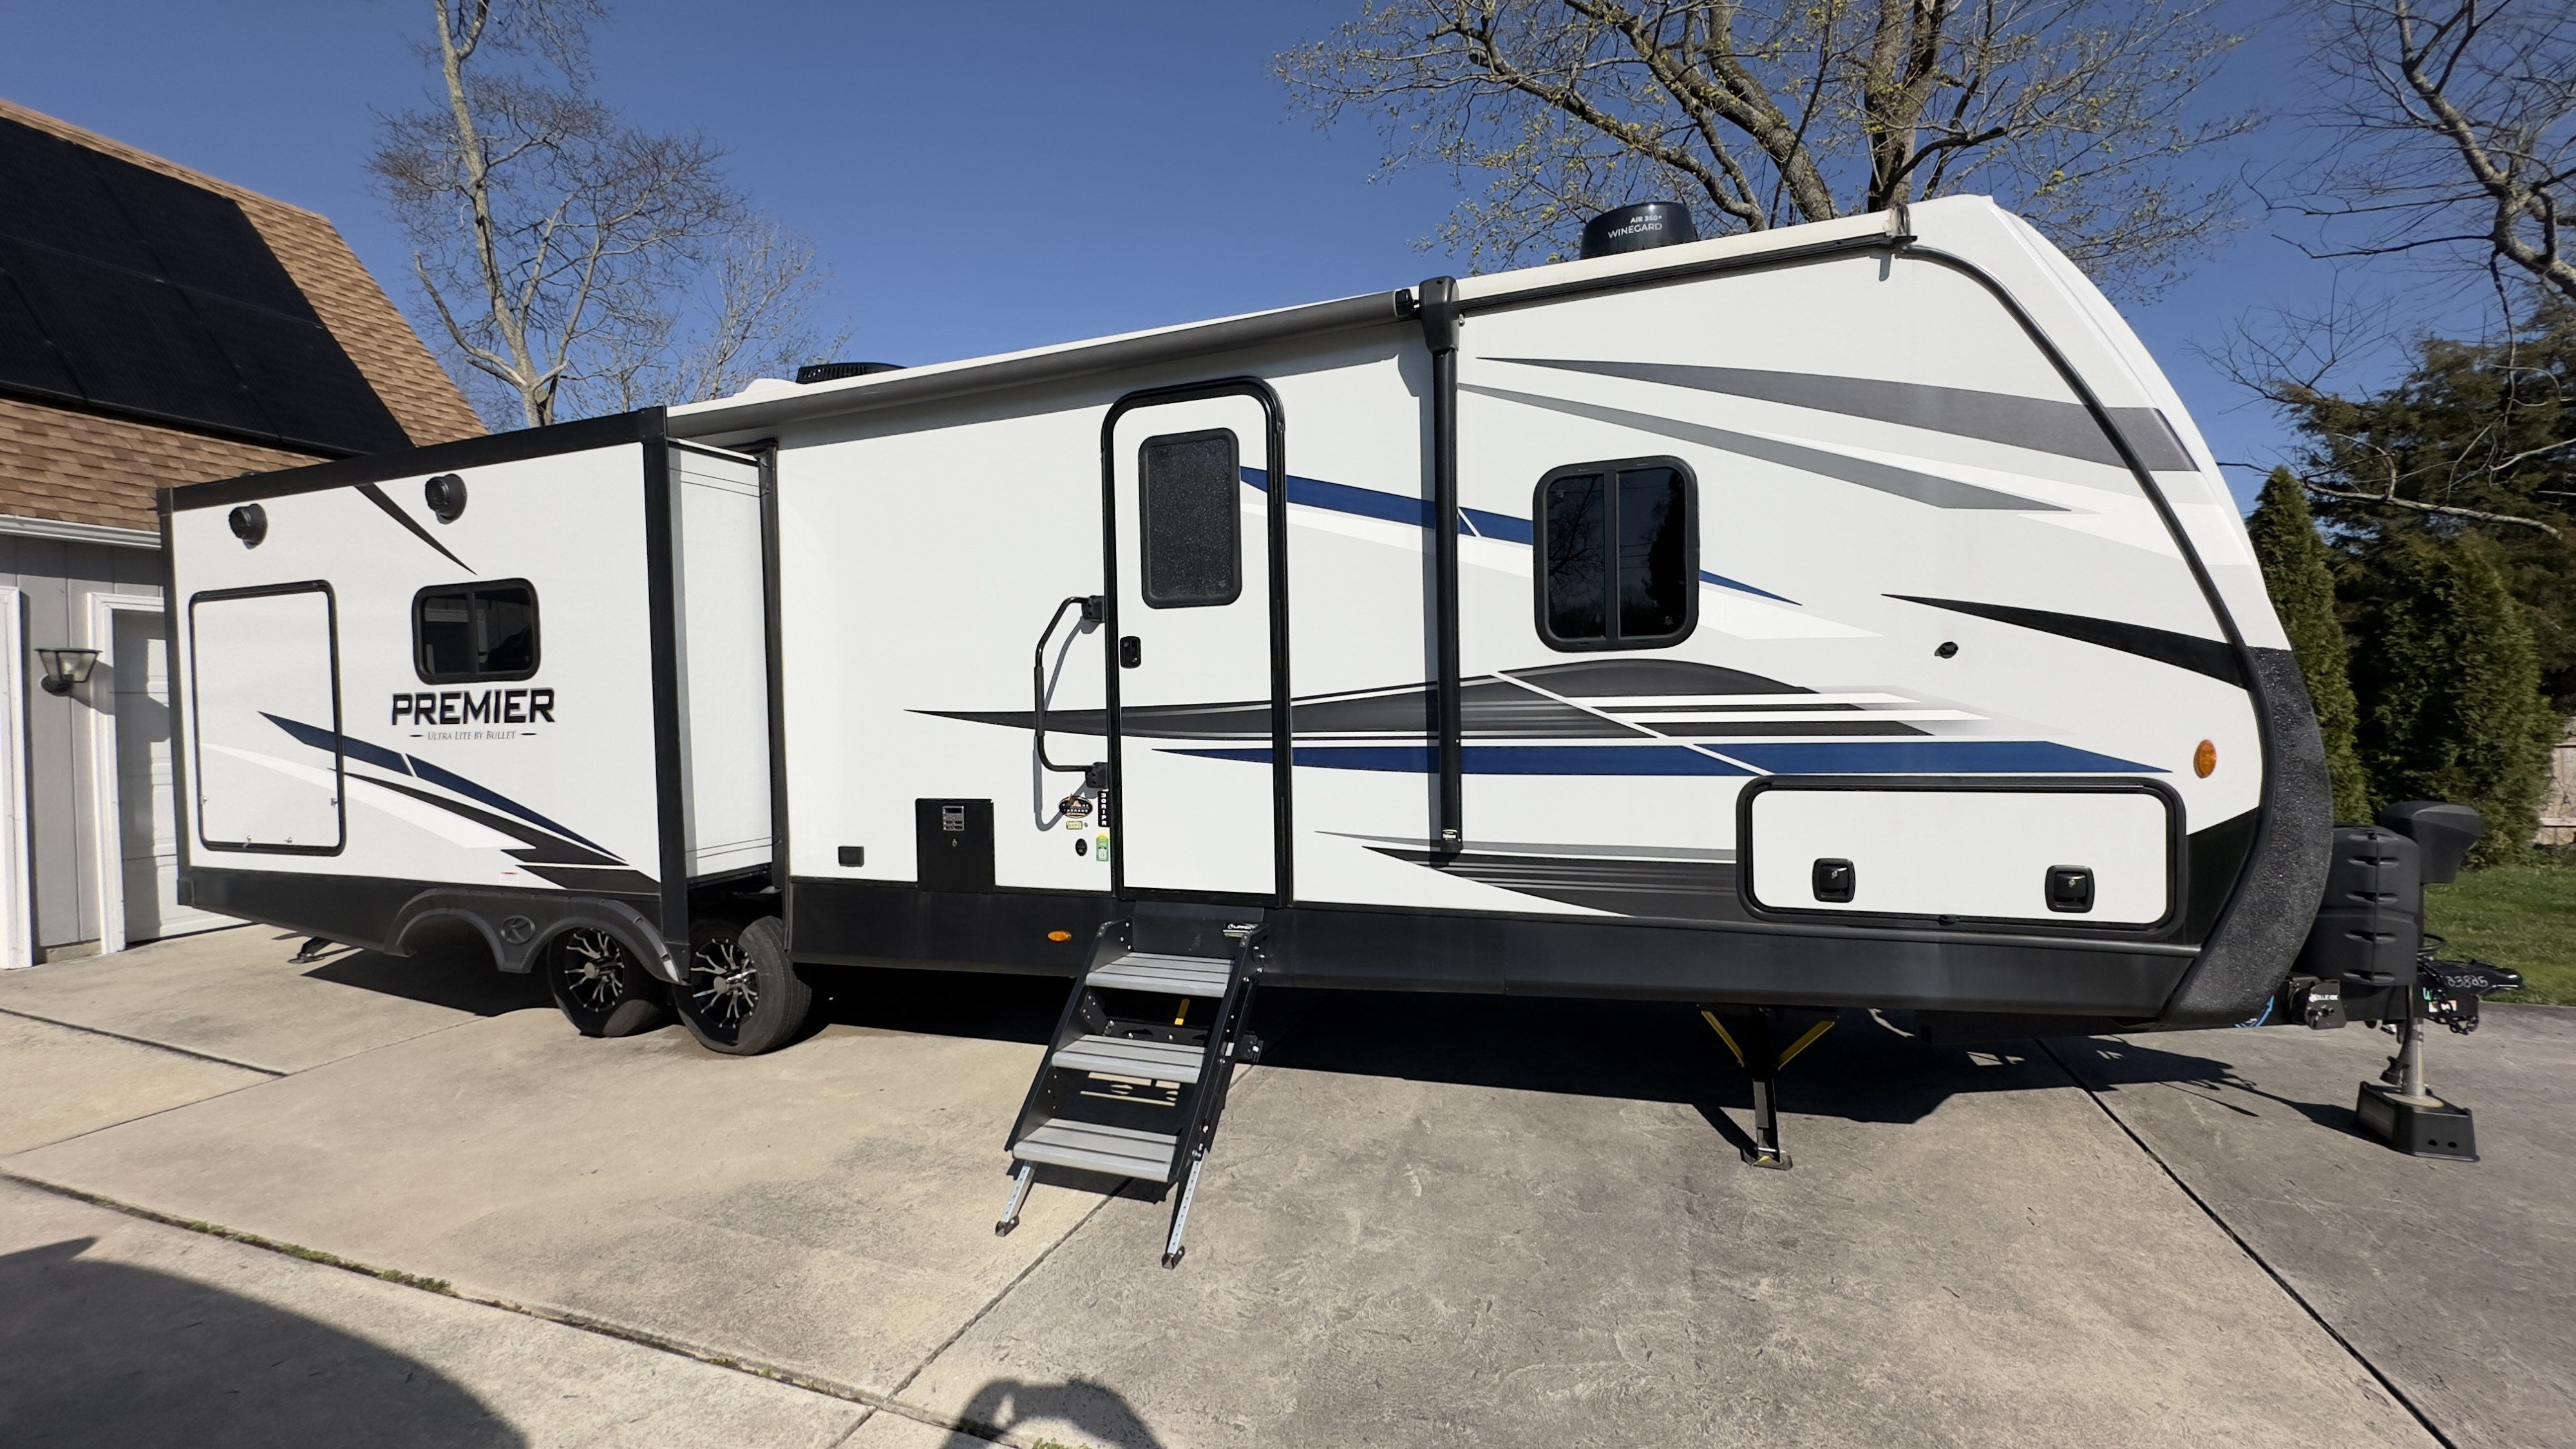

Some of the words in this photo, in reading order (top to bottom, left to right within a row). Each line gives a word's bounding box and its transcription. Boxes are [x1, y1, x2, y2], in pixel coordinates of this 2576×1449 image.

[1608, 223, 1662, 238] WINEGARD
[392, 687, 555, 725] PREMIER
[2445, 974, 2488, 988] 23825
